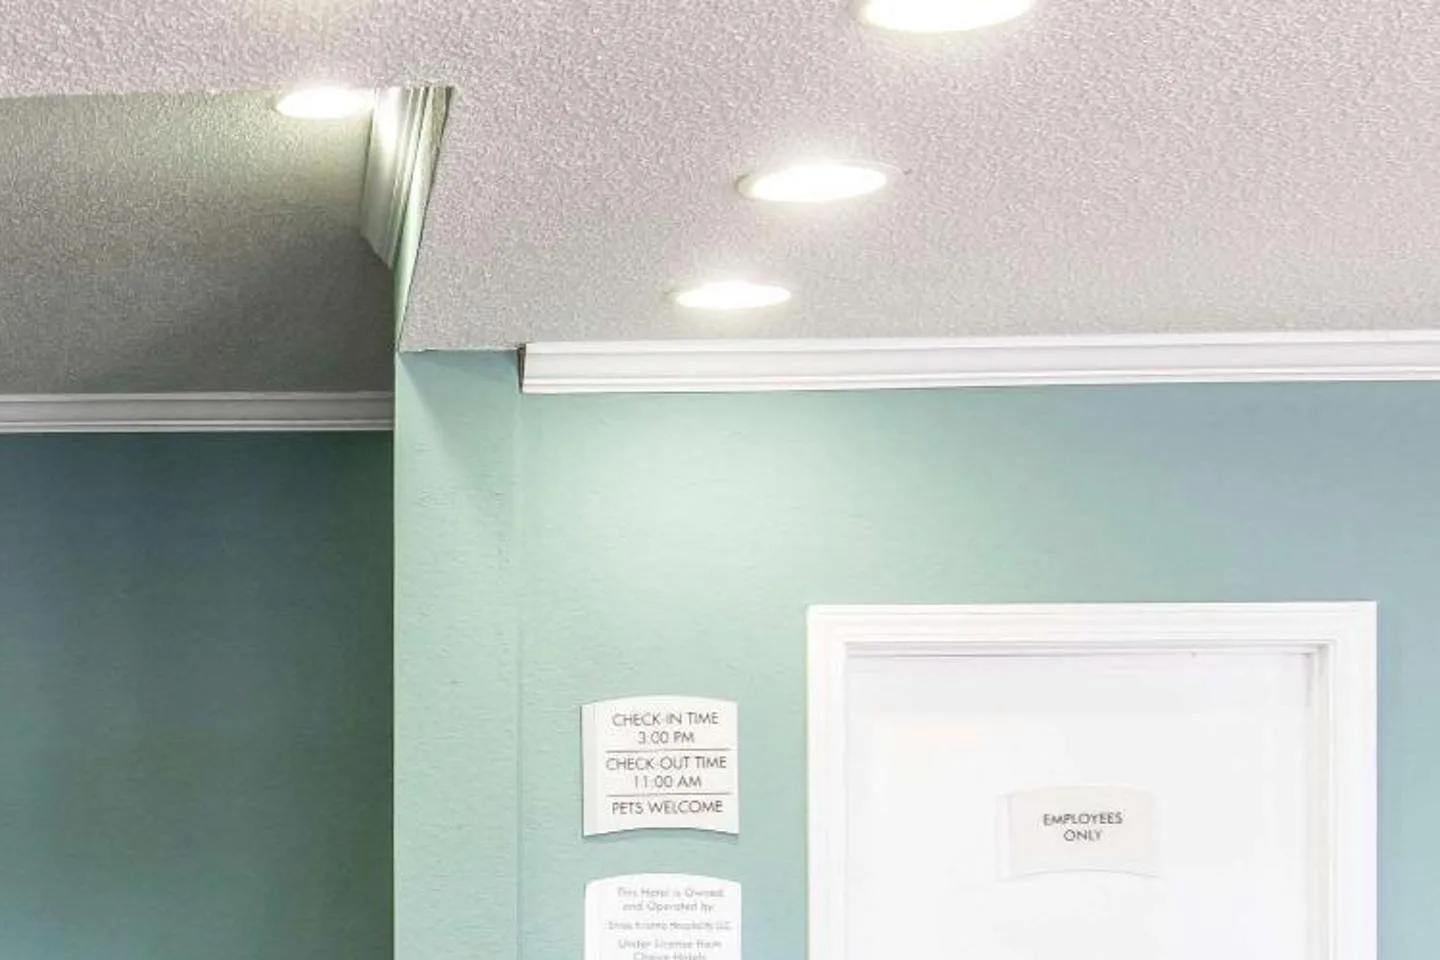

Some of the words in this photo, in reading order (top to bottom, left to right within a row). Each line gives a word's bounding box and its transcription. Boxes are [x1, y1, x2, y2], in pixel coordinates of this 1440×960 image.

[686, 712, 719, 725] TIME
[638, 731, 669, 744] 3:00
[673, 731, 696, 743] PM
[694, 756, 727, 769] TIME
[634, 776, 673, 788] 11:00
[677, 776, 702, 788] AM
[612, 802, 644, 814] PETS
[648, 800, 723, 814] WELCOME
[1043, 812, 1123, 826] EMPLOYEES
[1063, 829, 1102, 842] ONLY
[641, 886, 669, 897] Hotel
[685, 886, 724, 897] Owned
[622, 901, 644, 911] and
[647, 901, 697, 914] Operated
[700, 901, 714, 915] by
[618, 939, 651, 949] Under
[655, 938, 693, 949] License
